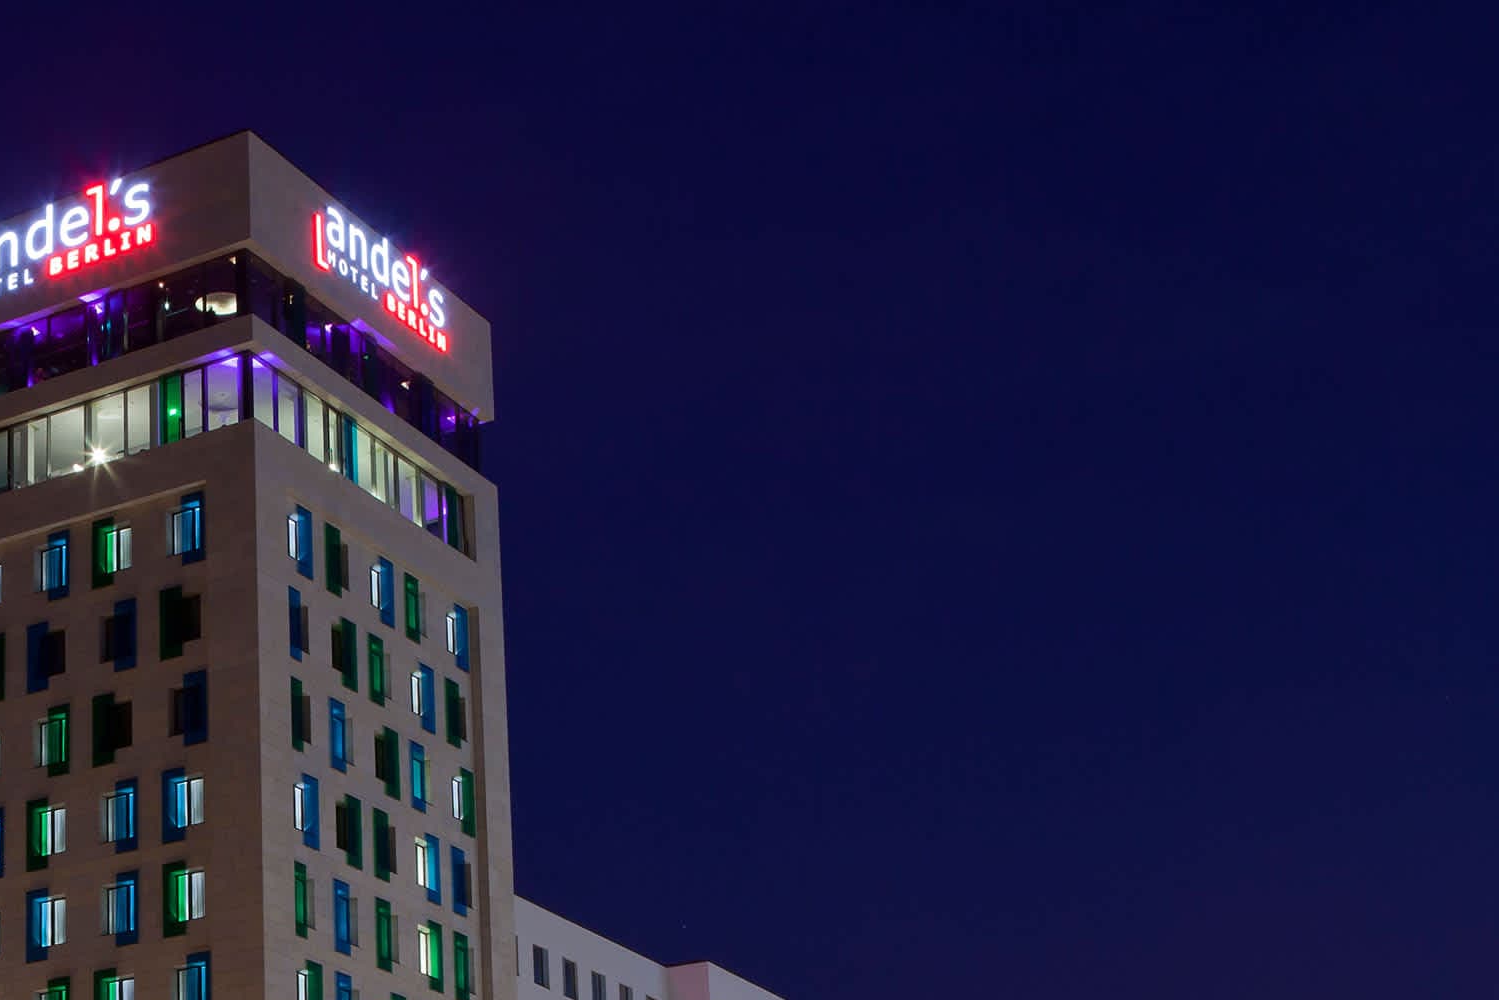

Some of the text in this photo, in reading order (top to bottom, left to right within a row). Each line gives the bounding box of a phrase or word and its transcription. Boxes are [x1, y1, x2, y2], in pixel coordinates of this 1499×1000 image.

[47, 223, 154, 276] BERLIN
[326, 251, 448, 353] HOTEL BERLIN
